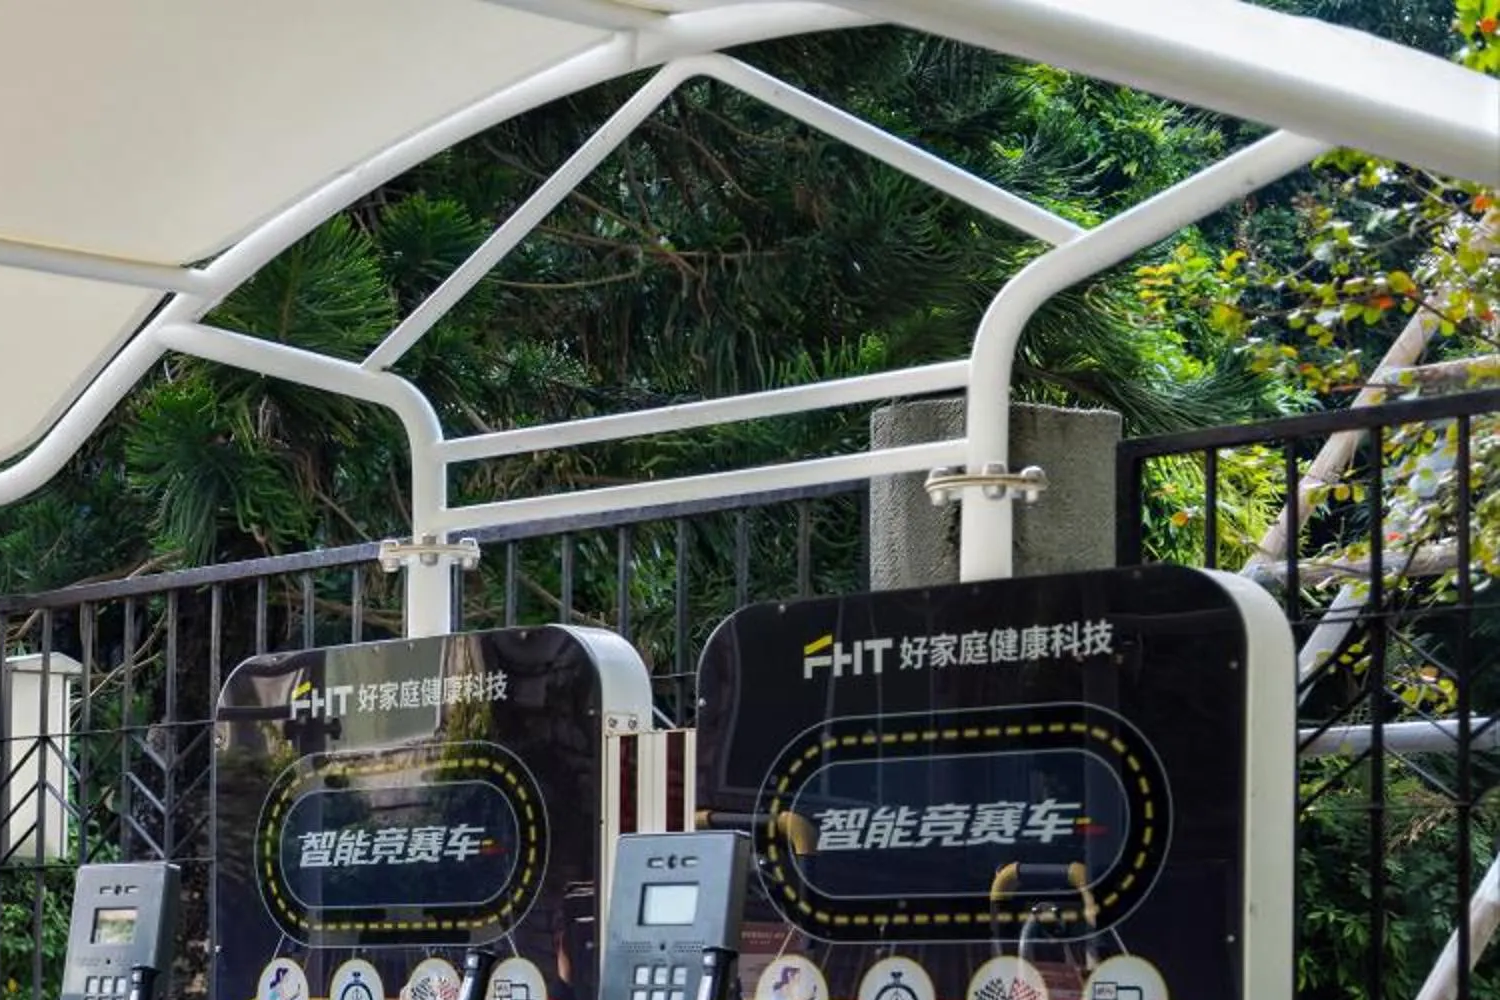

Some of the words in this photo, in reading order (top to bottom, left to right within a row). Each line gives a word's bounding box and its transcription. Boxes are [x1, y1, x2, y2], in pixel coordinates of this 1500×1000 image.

[900, 620, 1113, 670] 好家庭健康科技
[357, 671, 509, 713] 好家庭健康科技
[297, 822, 486, 869] 智能竞赛车
[812, 797, 1083, 853] 智能竞赛车
